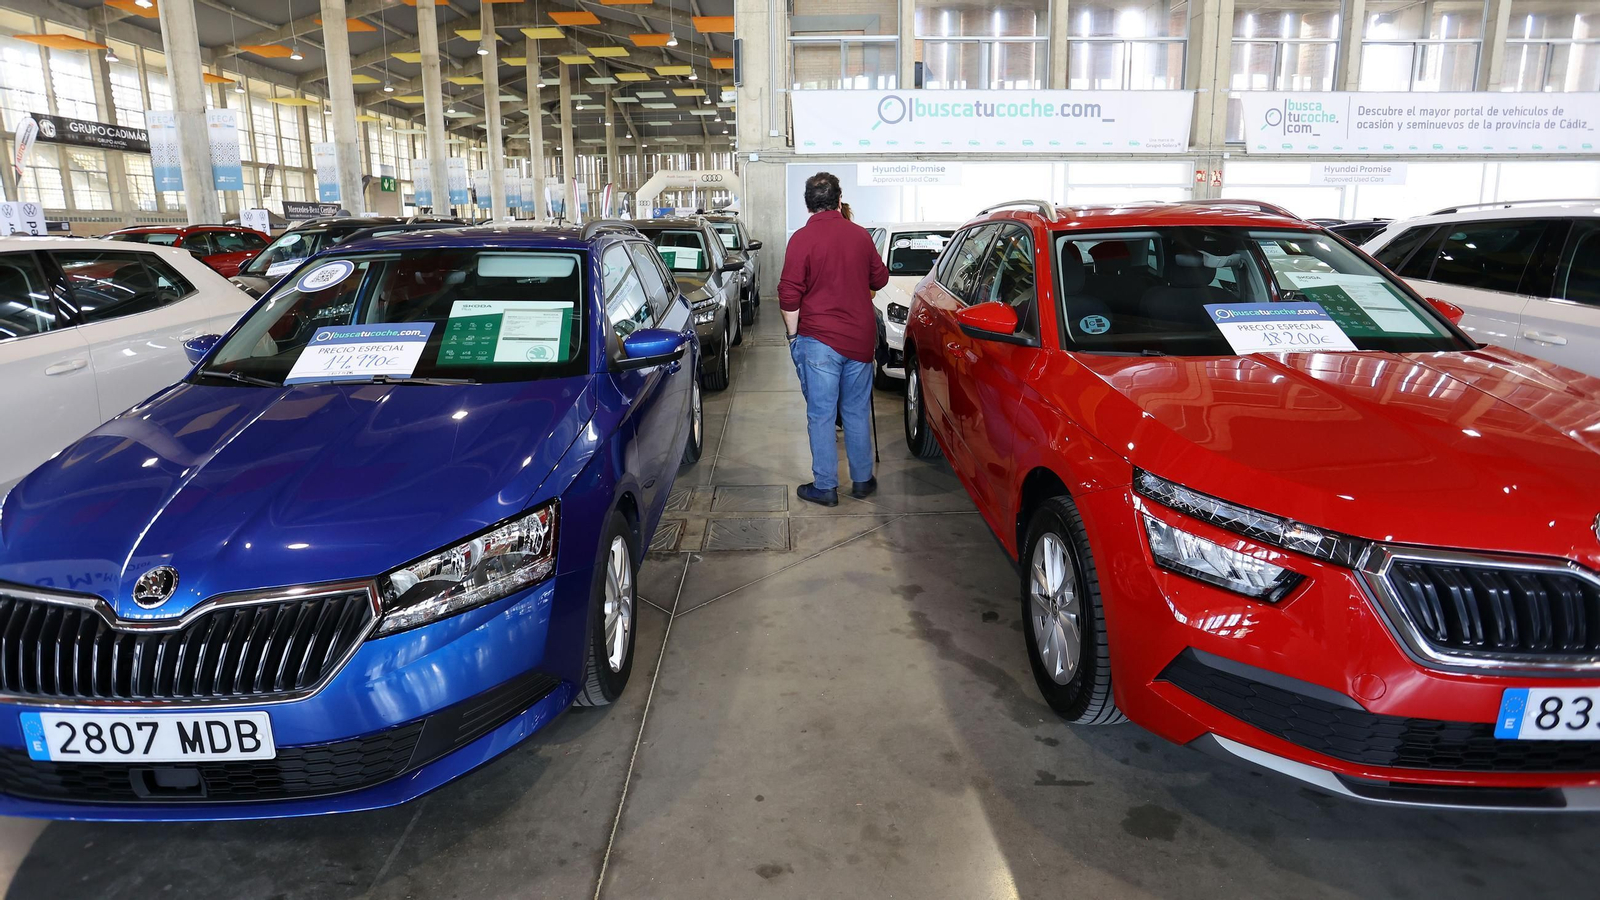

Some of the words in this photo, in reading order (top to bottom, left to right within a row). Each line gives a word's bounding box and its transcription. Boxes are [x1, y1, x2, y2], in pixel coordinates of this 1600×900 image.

[1288, 98, 1322, 111] busca
[1358, 106, 1403, 116] Descubre
[1406, 106, 1416, 116] el
[1419, 108, 1451, 118] mayor
[1454, 106, 1484, 118] portal
[1486, 106, 1499, 116] de
[1502, 105, 1549, 116] vehículos
[1552, 105, 1564, 116] de
[1356, 119, 1394, 129] ocasión
[1397, 121, 1404, 131] y
[1406, 119, 1464, 130] seminuevos
[1467, 119, 1480, 130] de
[1483, 119, 1492, 130] la
[1495, 119, 1541, 131] provincia
[1544, 119, 1556, 129] de
[69, 121, 106, 136] GRUPO
[107, 127, 148, 142] CADIMÁR
[872, 164, 909, 174] Hyundai
[910, 164, 946, 173] Promise
[1324, 164, 1358, 174] Hyundai
[1360, 164, 1392, 173] Promise
[1237, 323, 1275, 331] PRECIO
[318, 345, 356, 354] PRECIO
[358, 344, 404, 353] ESPECIAL
[1535, 696, 1600, 731] 83
[1504, 717, 1516, 729] E
[55, 721, 159, 755] 2807
[176, 720, 262, 754] MDB
[33, 741, 42, 751] E
